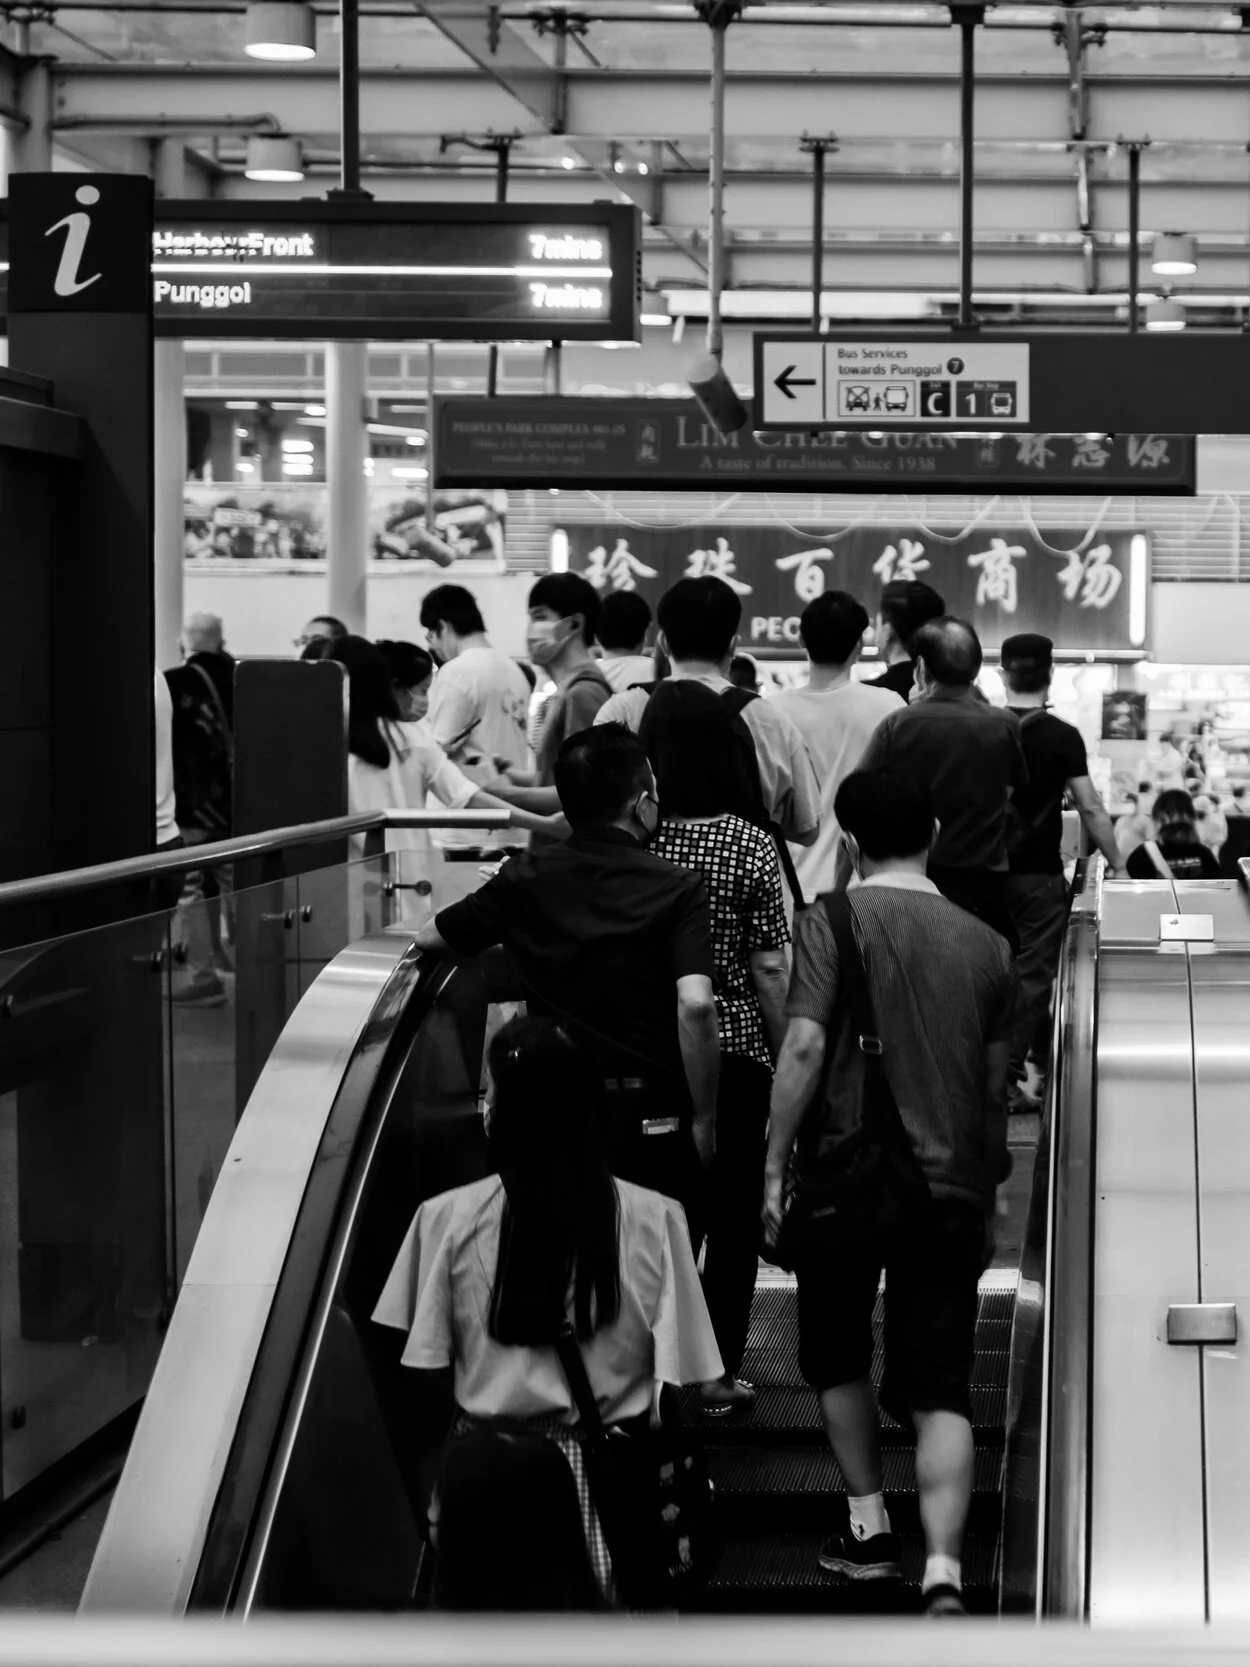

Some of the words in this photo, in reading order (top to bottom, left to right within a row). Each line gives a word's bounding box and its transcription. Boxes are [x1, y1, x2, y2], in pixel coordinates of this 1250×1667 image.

[154, 281, 251, 308] Punggol
[838, 348, 858, 359] Bus
[862, 348, 908, 359] Services
[838, 364, 887, 376] towards
[890, 364, 943, 377] Punggol
[927, 392, 944, 415] C
[965, 393, 977, 415] 1
[676, 416, 739, 447] LIM
[700, 454, 714, 469] A
[851, 455, 893, 470] Since
[899, 456, 936, 471] 1938
